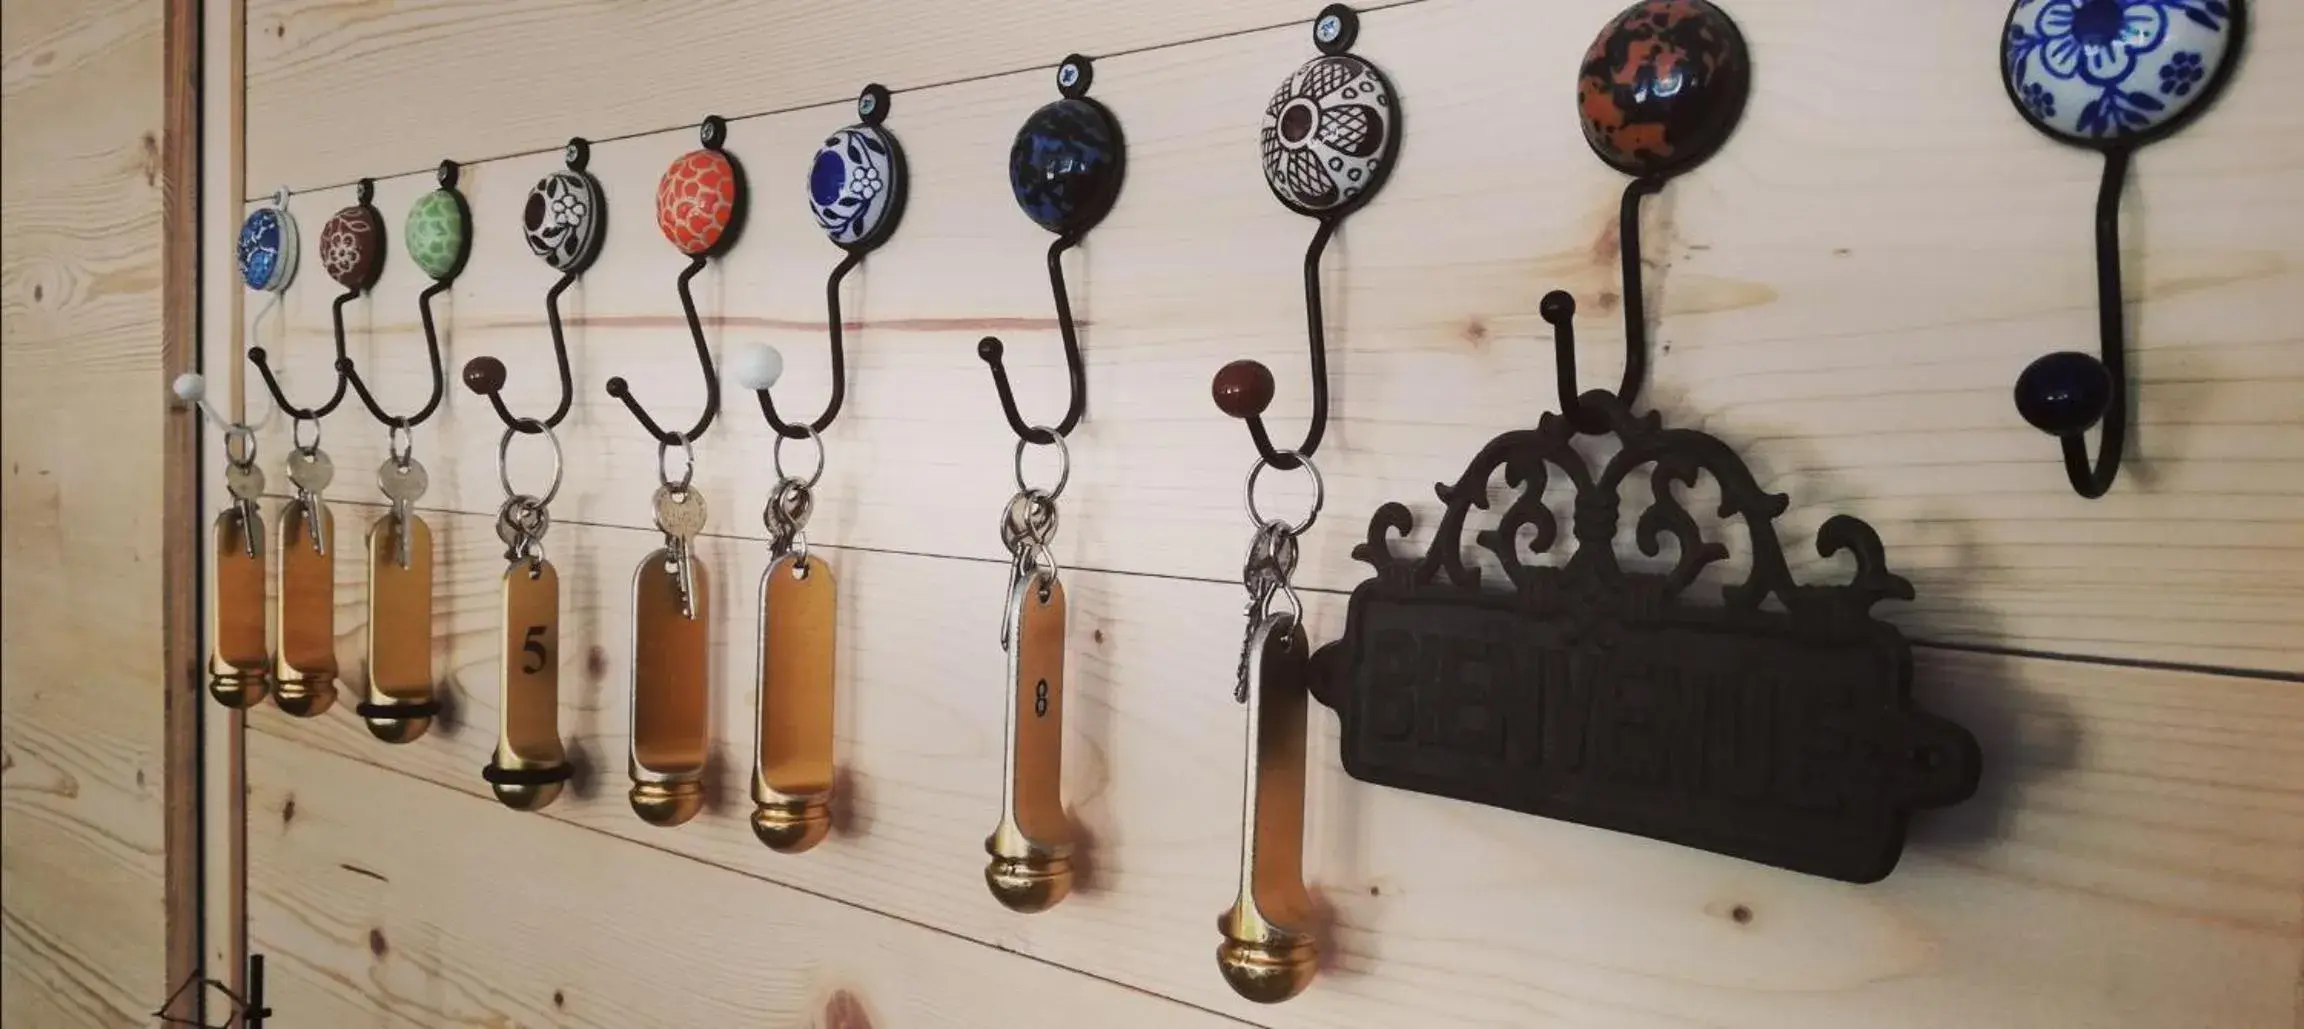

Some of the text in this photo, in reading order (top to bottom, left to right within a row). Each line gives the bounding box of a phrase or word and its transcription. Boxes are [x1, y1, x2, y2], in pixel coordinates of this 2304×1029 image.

[523, 626, 547, 674] 5
[1036, 678, 1048, 717] 8
[1370, 628, 1857, 815] BIENVENUE
